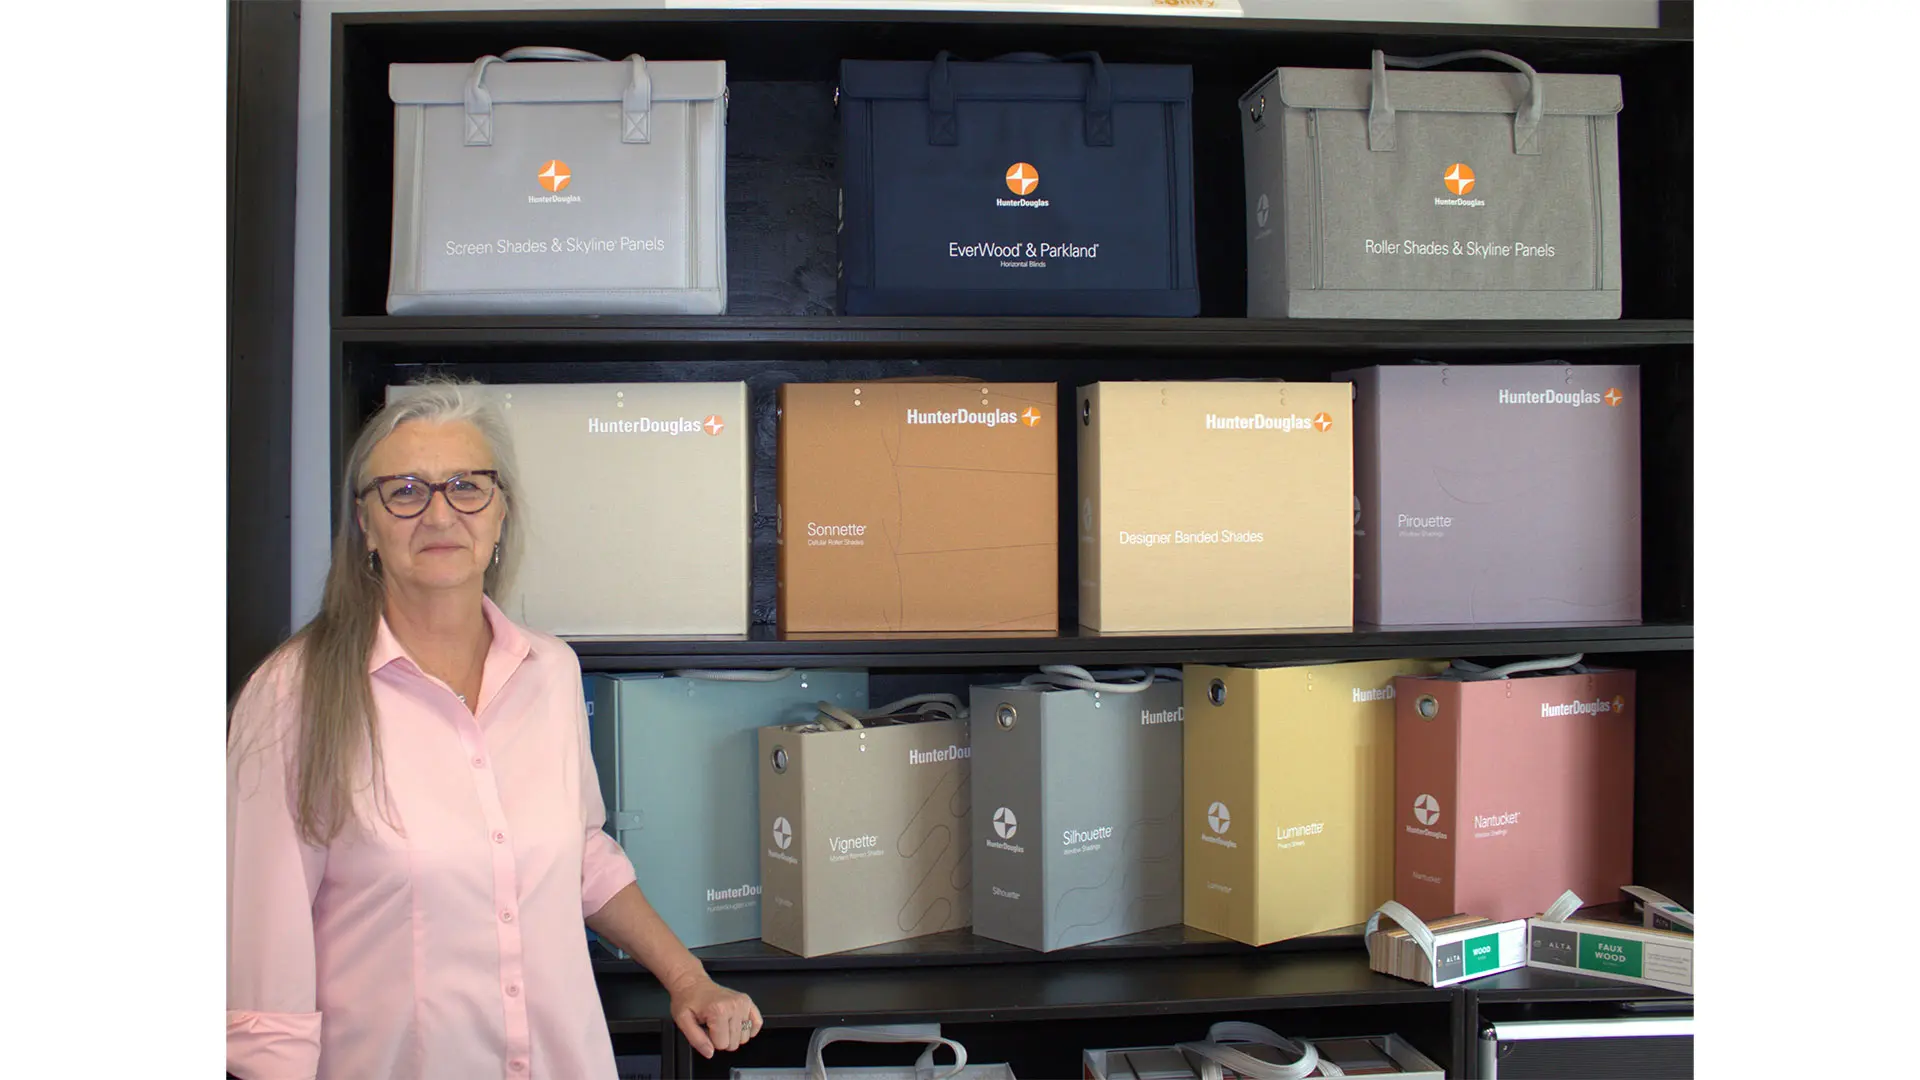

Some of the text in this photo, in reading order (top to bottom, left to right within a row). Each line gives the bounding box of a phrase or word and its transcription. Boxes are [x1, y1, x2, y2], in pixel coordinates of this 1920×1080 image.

[528, 195, 581, 204] HunterDouglas
[996, 198, 1049, 208] HunterDouglas
[1434, 197, 1485, 207] HunterDouglas
[445, 236, 665, 256] Screen Shades & Skyline Panels
[949, 242, 1097, 257] EverWood & Parkland
[1365, 239, 1555, 259] Roller Shades & Skyline Panels
[1000, 260, 1046, 268] Horizontal Blinds
[1499, 389, 1601, 407] HunterDouglas
[907, 408, 1018, 427] HunterDouglas
[1206, 414, 1312, 432] HunterDouglas
[588, 417, 701, 435] HunterDouglas
[807, 521, 865, 536] Sonnette
[1398, 513, 1452, 528] Pirouette
[1119, 529, 1264, 547] Designer Banded Shades
[1541, 698, 1610, 718] HunterDouglas
[1474, 811, 1519, 829] Nantucket
[1062, 826, 1113, 846] Silhouette
[1276, 822, 1324, 840] Luminette
[829, 834, 878, 854] Vignette
[1472, 945, 1491, 956] WOOD
[1548, 942, 1571, 951] ALTA
[1597, 943, 1623, 953] FAUX
[1446, 955, 1461, 963] ALTA
[1594, 951, 1626, 963] WOOD
